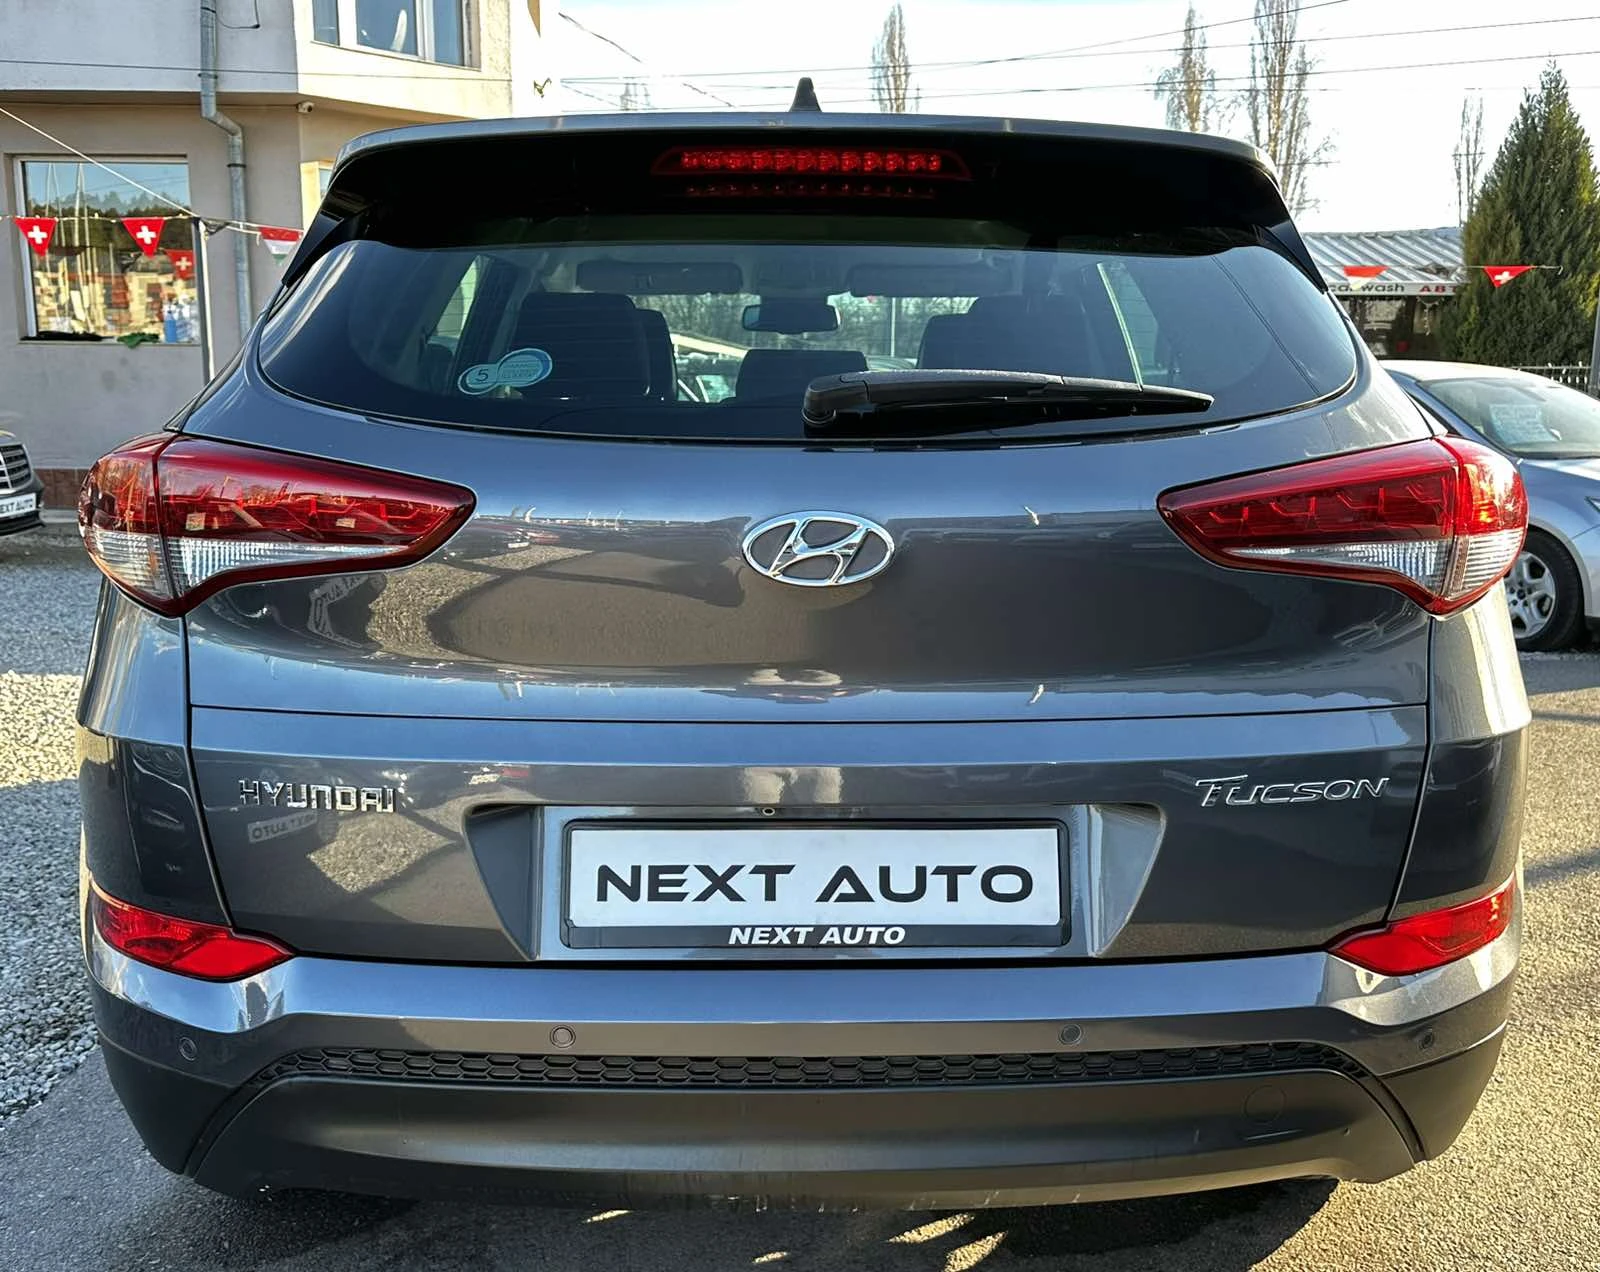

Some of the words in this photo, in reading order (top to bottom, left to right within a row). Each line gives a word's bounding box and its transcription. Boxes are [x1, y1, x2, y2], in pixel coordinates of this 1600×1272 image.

[1329, 283, 1352, 293] ca
[1359, 282, 1405, 293] wash
[475, 368, 489, 382] 5
[239, 780, 394, 813] HYUNDAI
[1195, 774, 1390, 807] TUCSON
[597, 864, 796, 902] NEXT
[815, 864, 1034, 903] AUTO
[728, 926, 812, 945] NEXT
[818, 926, 906, 945] AUTO
